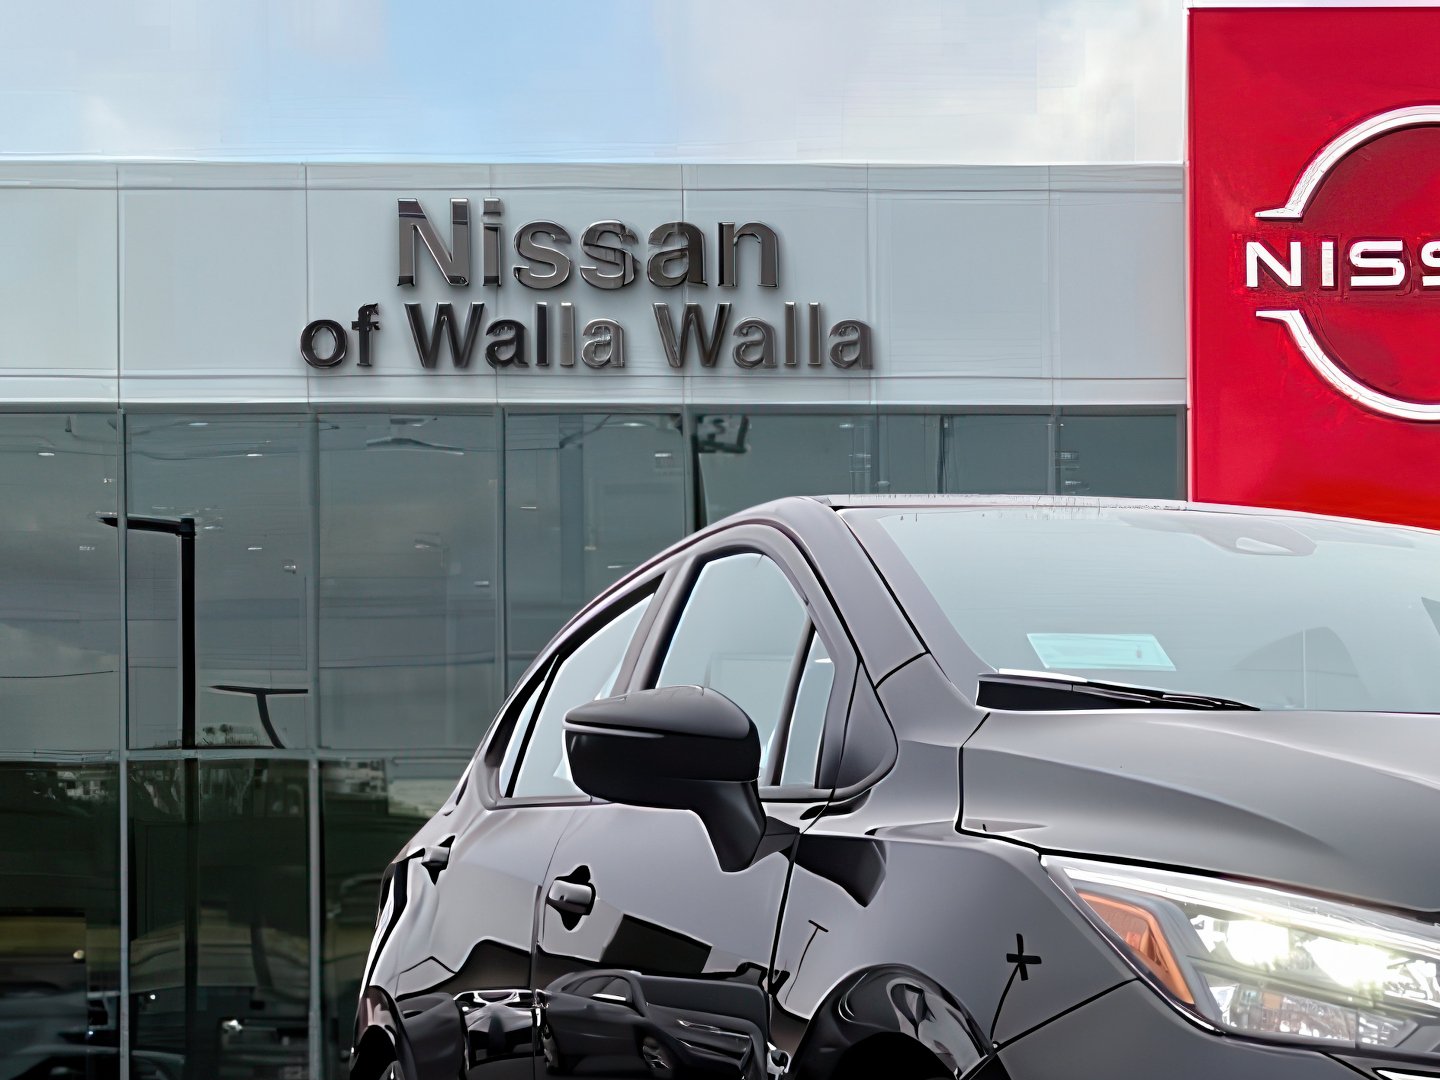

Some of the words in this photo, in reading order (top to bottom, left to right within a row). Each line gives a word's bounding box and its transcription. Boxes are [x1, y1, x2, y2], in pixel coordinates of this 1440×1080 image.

[397, 198, 780, 289] Nissan
[300, 302, 381, 369] of
[403, 301, 627, 370] Walla
[652, 301, 874, 371] Walla
